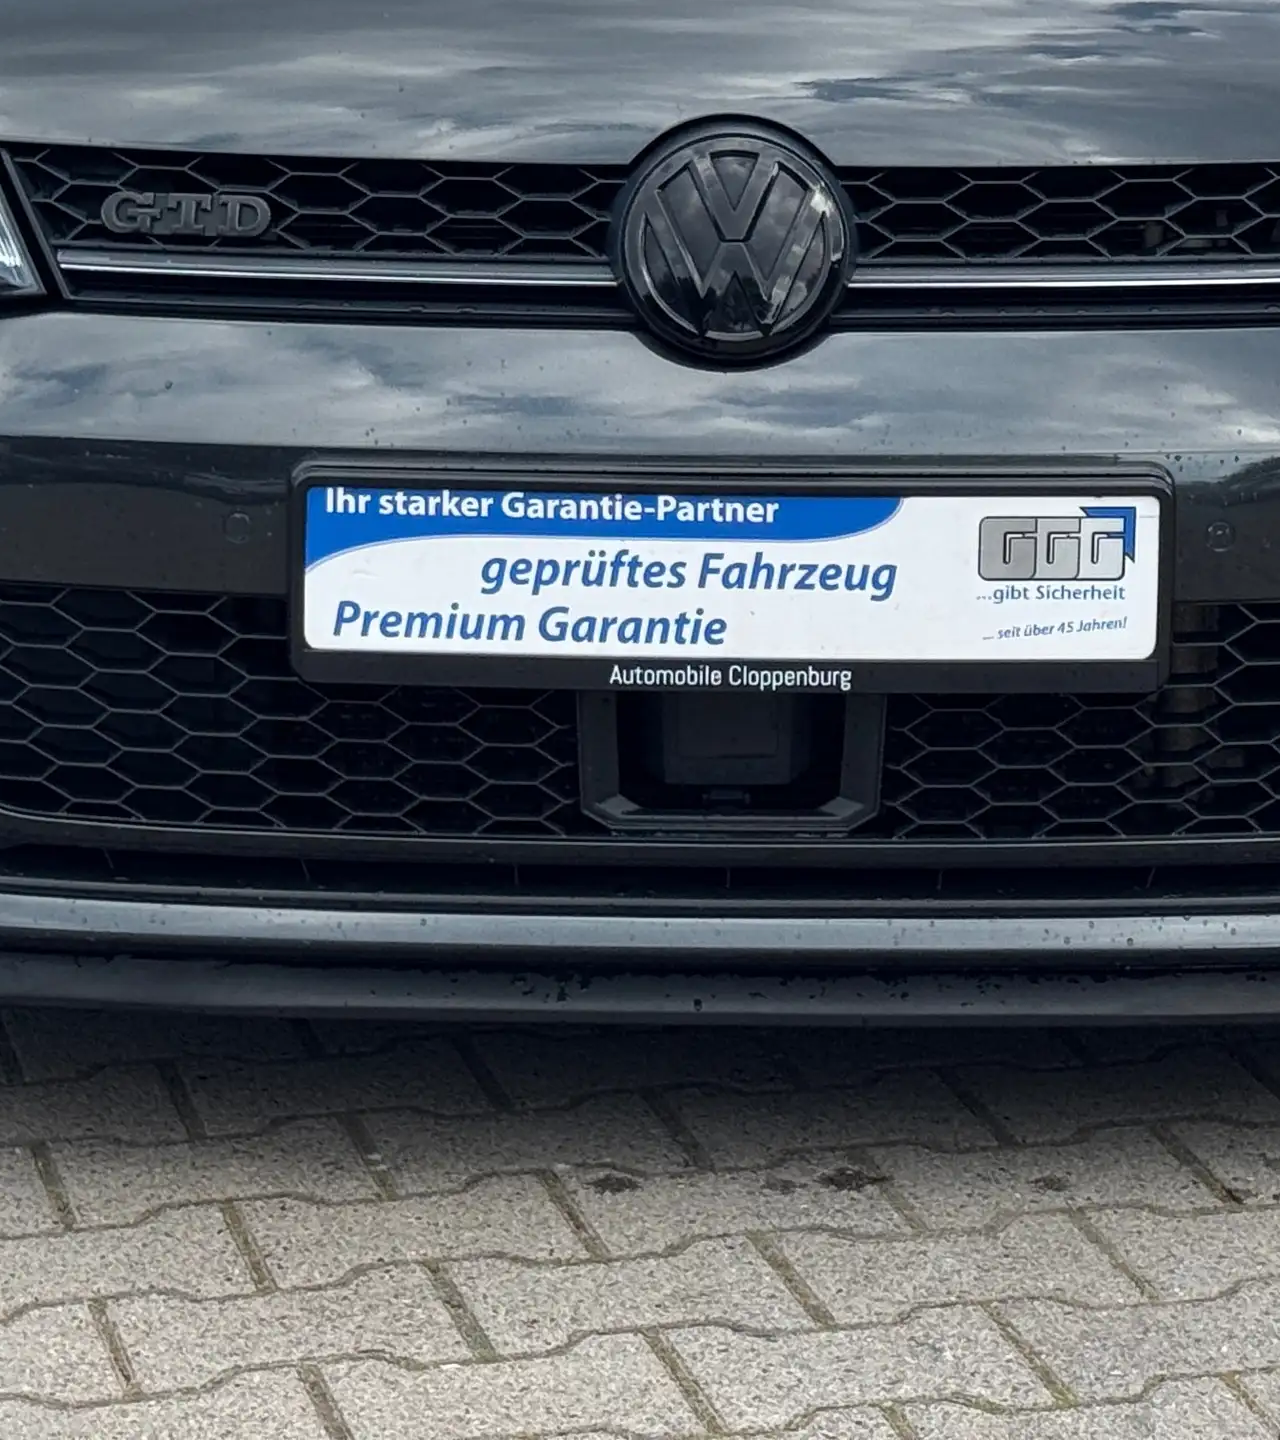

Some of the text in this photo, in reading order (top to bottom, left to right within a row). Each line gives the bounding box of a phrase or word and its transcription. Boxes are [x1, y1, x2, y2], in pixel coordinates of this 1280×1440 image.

[100, 190, 272, 237] GTD
[325, 487, 780, 524] Ihr starker Garantie-Partner
[481, 549, 898, 601] geprüftes Fahrzeug
[976, 585, 1126, 604] ...gibt Sicherheit
[332, 600, 728, 645] Premium Garantie
[997, 626, 1021, 640] seit
[1023, 623, 1056, 638] über
[1057, 620, 1074, 634] 45
[1076, 616, 1127, 633] Jahren!
[609, 664, 852, 691] Automobile Cloppenburg
